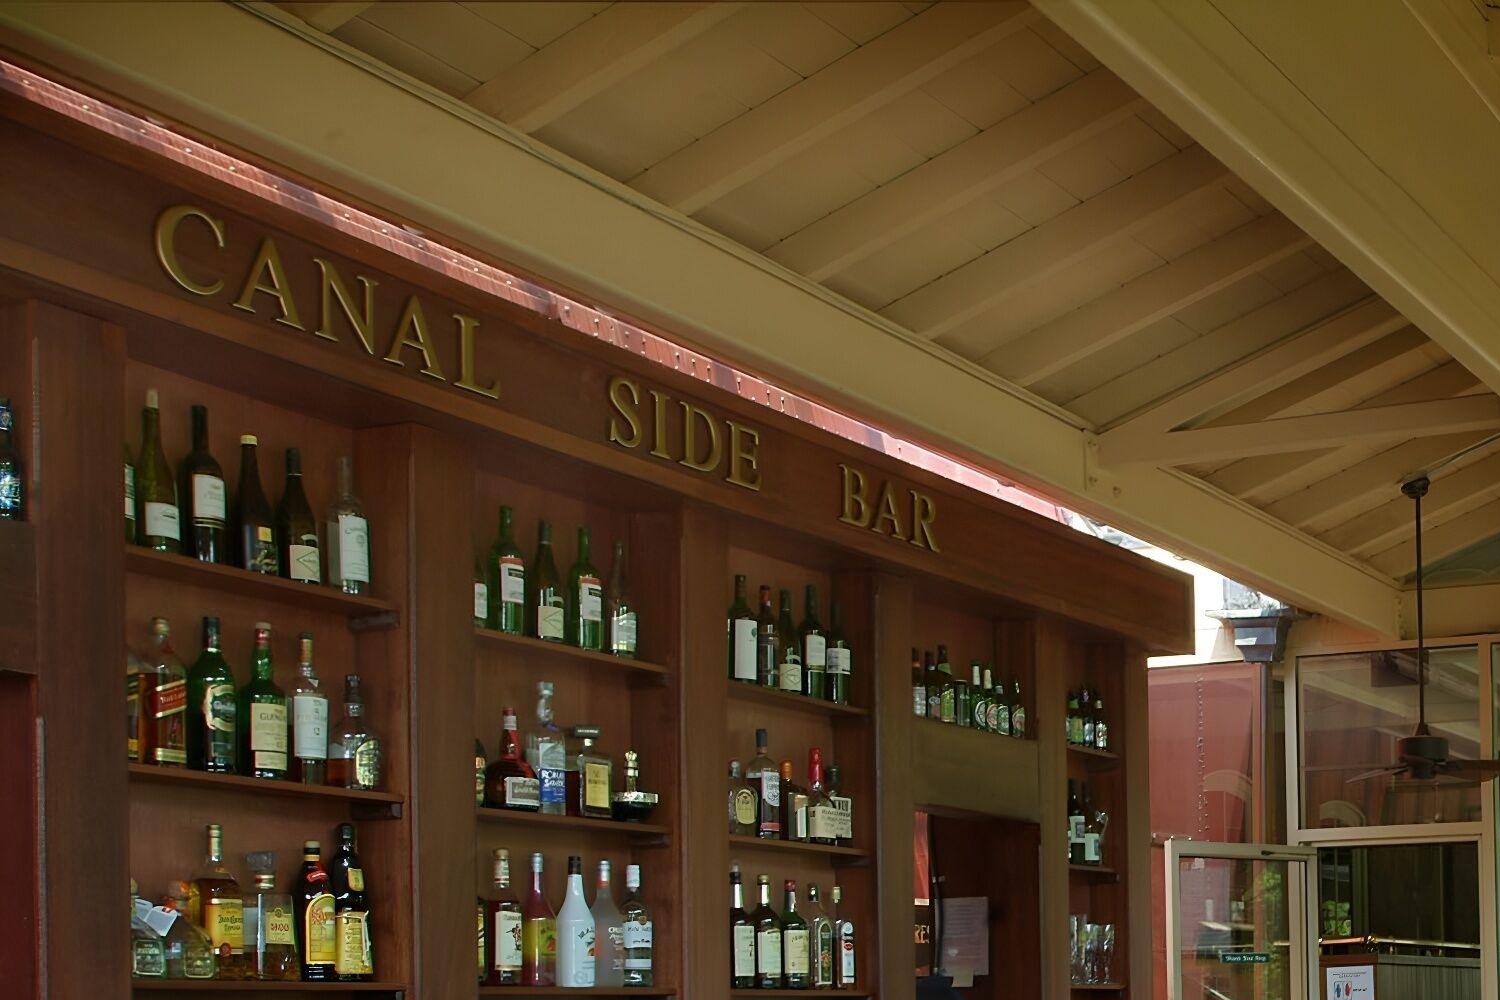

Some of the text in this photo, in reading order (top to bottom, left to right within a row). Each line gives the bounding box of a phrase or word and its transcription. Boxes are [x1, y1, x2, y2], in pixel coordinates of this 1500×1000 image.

[154, 204, 940, 553] CANAL SIDE BAR
